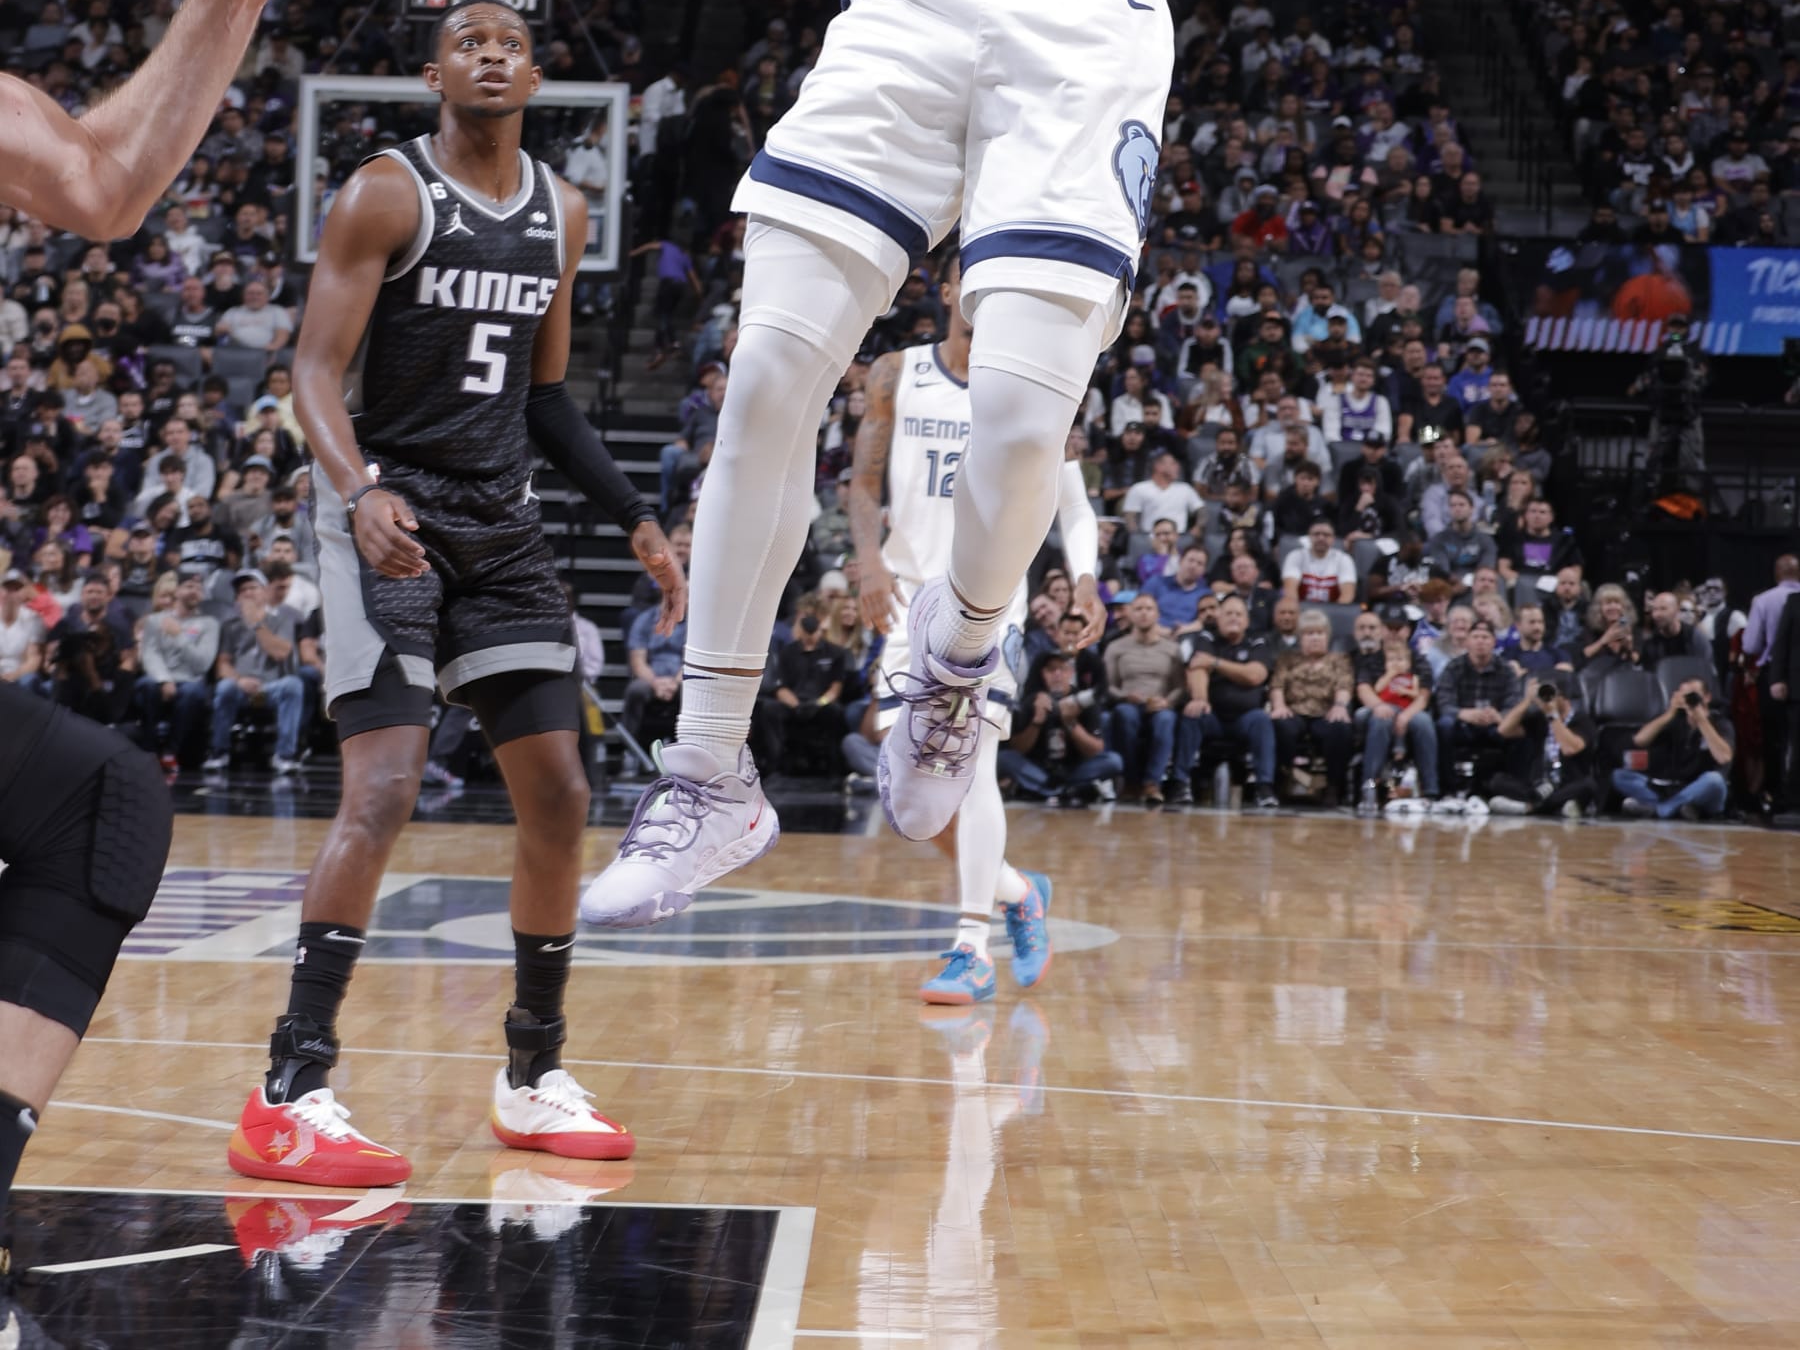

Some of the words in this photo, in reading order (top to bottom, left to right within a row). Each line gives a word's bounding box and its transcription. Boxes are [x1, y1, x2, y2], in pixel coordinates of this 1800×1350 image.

[525, 226, 557, 241] dialpad
[416, 266, 560, 316] KINGS
[460, 322, 512, 394] 5
[926, 450, 962, 499] 12
